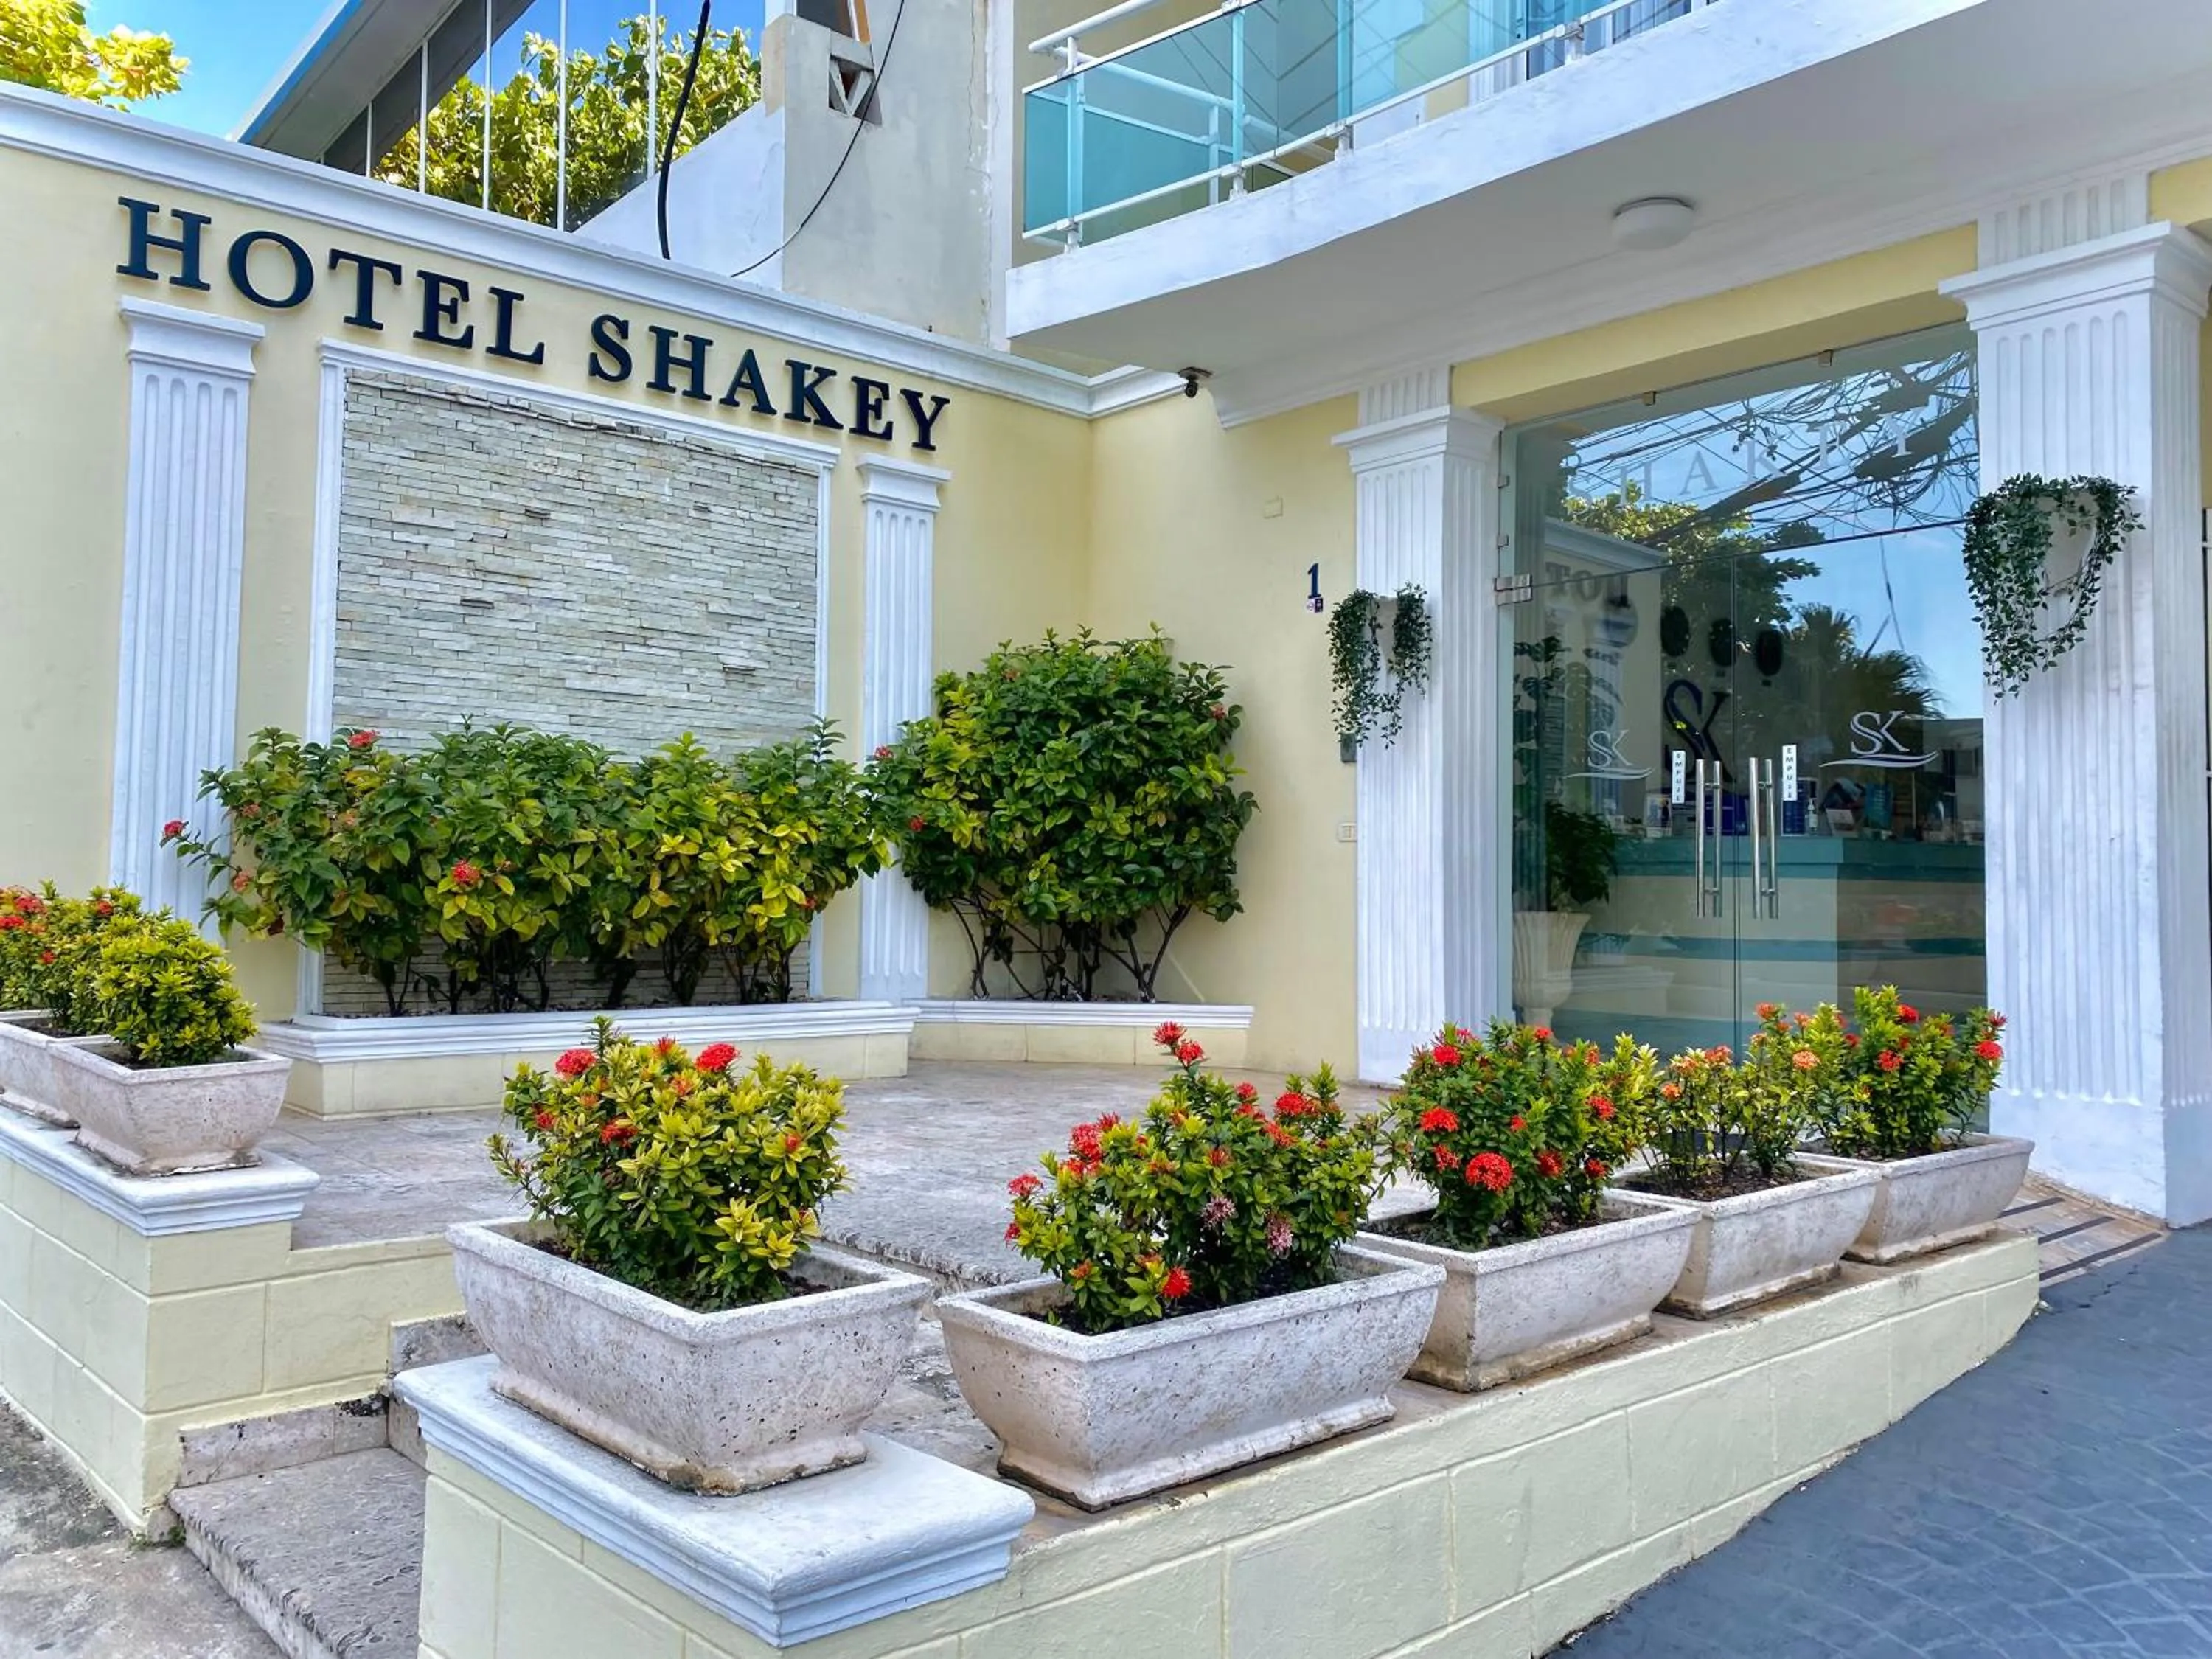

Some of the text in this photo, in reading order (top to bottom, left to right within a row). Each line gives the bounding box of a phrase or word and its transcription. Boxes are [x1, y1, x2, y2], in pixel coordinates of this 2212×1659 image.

[116, 195, 950, 451] HOTEL SHAKEY
[1307, 563, 1322, 599] 1
[1587, 728, 1634, 768] SK
[1850, 710, 1910, 755] SK
